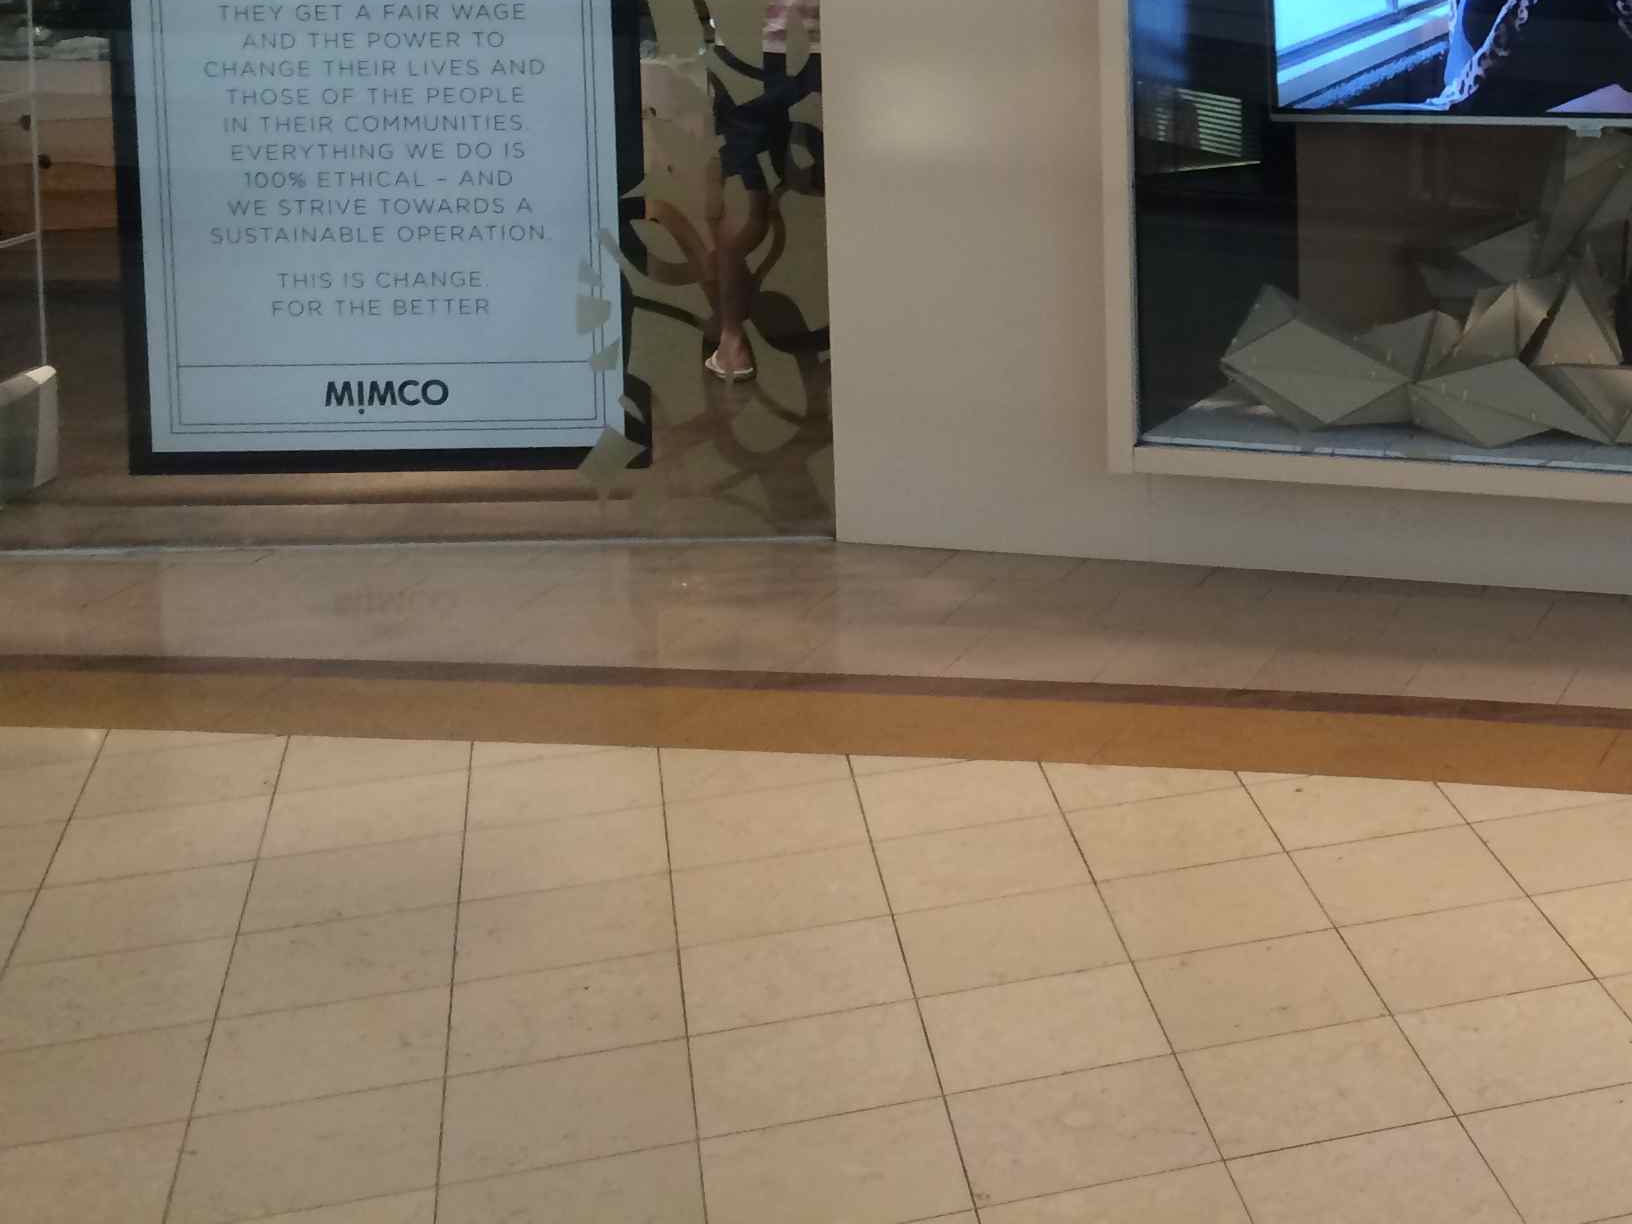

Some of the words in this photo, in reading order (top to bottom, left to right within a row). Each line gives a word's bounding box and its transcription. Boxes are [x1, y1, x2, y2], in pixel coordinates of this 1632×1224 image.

[218, 5, 283, 21] THEY
[295, 5, 343, 21] GET
[355, 5, 371, 20] A
[383, 4, 440, 20] FAIR
[452, 3, 526, 20] WAGE
[242, 33, 296, 49] AND
[308, 33, 353, 48] THE
[368, 32, 461, 49] POWER
[472, 32, 504, 47] TO
[203, 61, 311, 77] CHANGE
[323, 60, 396, 77] THEIR
[409, 59, 480, 76] LIVES
[491, 59, 545, 76] AND
[226, 88, 311, 105] THOSE
[323, 88, 354, 104] OF
[368, 88, 414, 104] THE
[427, 87, 525, 104] PEOPLE
[224, 117, 248, 133] IN
[261, 116, 334, 132] THEIR
[232, 144, 394, 161] EVERYTHING
[407, 143, 445, 159] WE
[456, 142, 492, 160] DO
[504, 142, 526, 159] IS
[244, 172, 307, 189] 100%
[317, 171, 425, 188] ETHICAL
[459, 170, 513, 186] AND
[228, 200, 266, 216] WE
[278, 199, 368, 216] STRIVE
[379, 198, 505, 215] TOWARDS
[516, 197, 533, 214] A
[209, 227, 385, 244] SUSTAINABLE
[277, 272, 332, 289] THIS
[344, 272, 364, 288] IS
[272, 300, 324, 317] FOR
[336, 299, 381, 316] THE
[393, 298, 489, 315] BETTER
[324, 379, 449, 415] MIMCO
